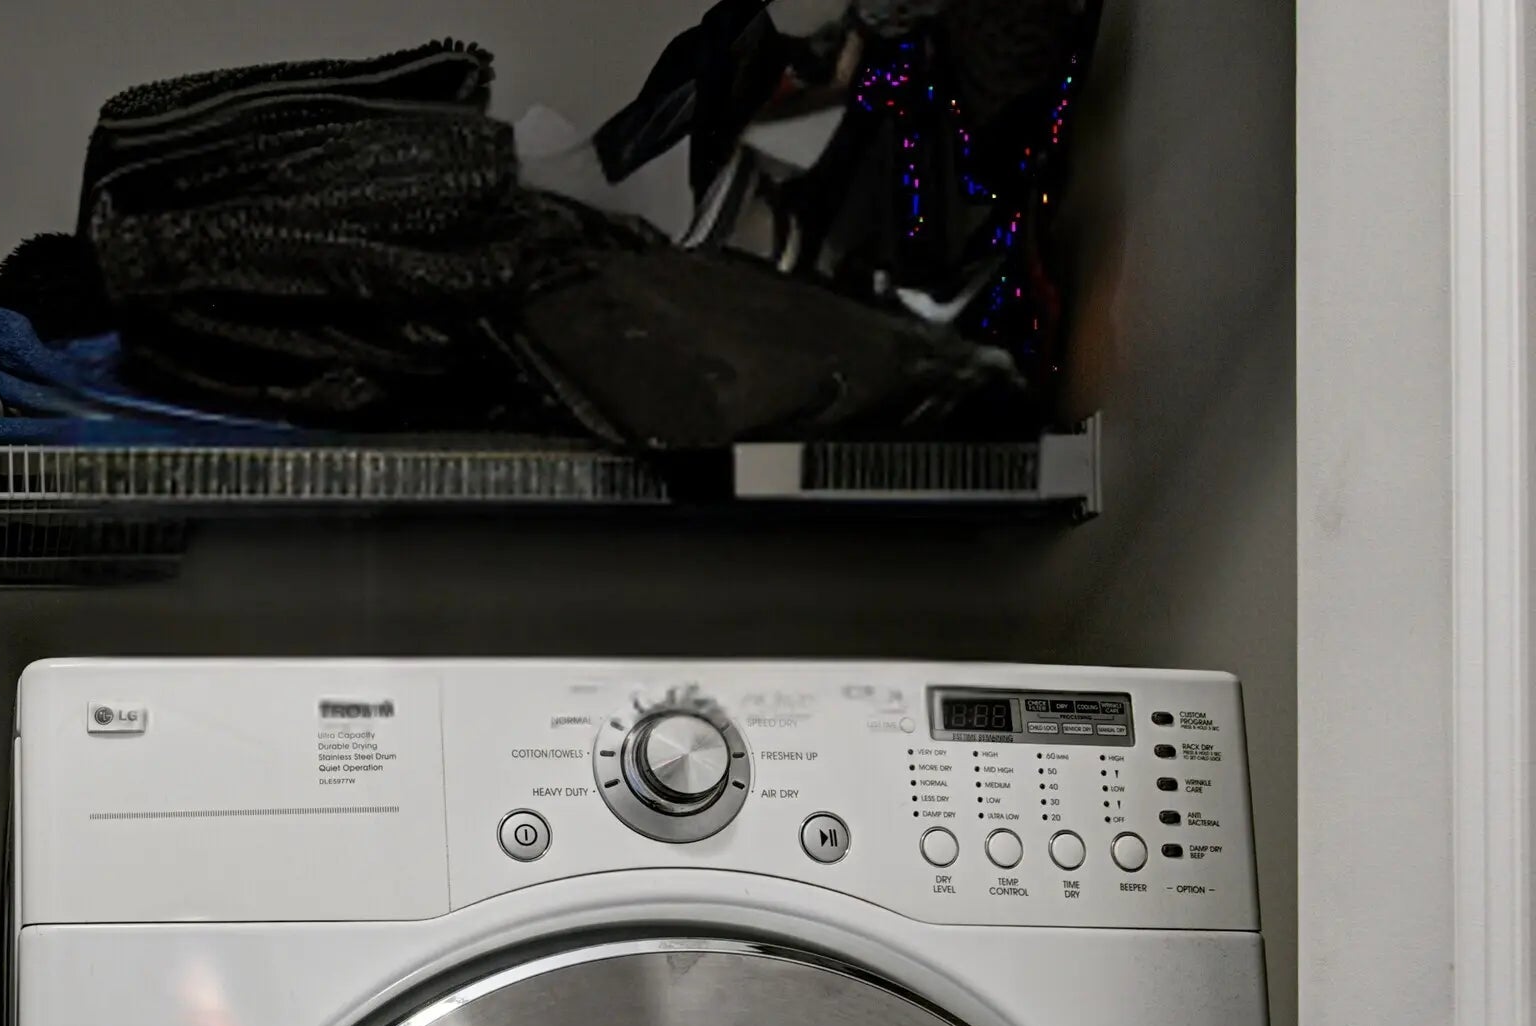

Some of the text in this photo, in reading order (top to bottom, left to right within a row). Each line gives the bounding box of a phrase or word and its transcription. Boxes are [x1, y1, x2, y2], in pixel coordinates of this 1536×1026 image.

[118, 711, 138, 721] LG
[779, 719, 798, 728] DRY
[338, 731, 375, 740] Capacity
[352, 742, 378, 750] Drying
[318, 753, 351, 761] Stainless
[511, 749, 583, 758] COTTON/TOWELS
[761, 751, 818, 760] FRESHEN UP
[319, 764, 383, 772] Quiet Operation
[1185, 779, 1211, 787] WRINKLE
[532, 788, 588, 796] HEAVY DUTY
[761, 789, 799, 798] AIR DRY
[1188, 819, 1220, 827] BACTERIAL
[936, 876, 952, 884] DRY
[933, 885, 956, 893] LEVEL
[1063, 881, 1080, 889] TIME
[1120, 883, 1147, 892] BEEPER
[989, 887, 1029, 896] CONTROL
[1177, 885, 1205, 894] OPTION
[1064, 890, 1080, 898] DRY
